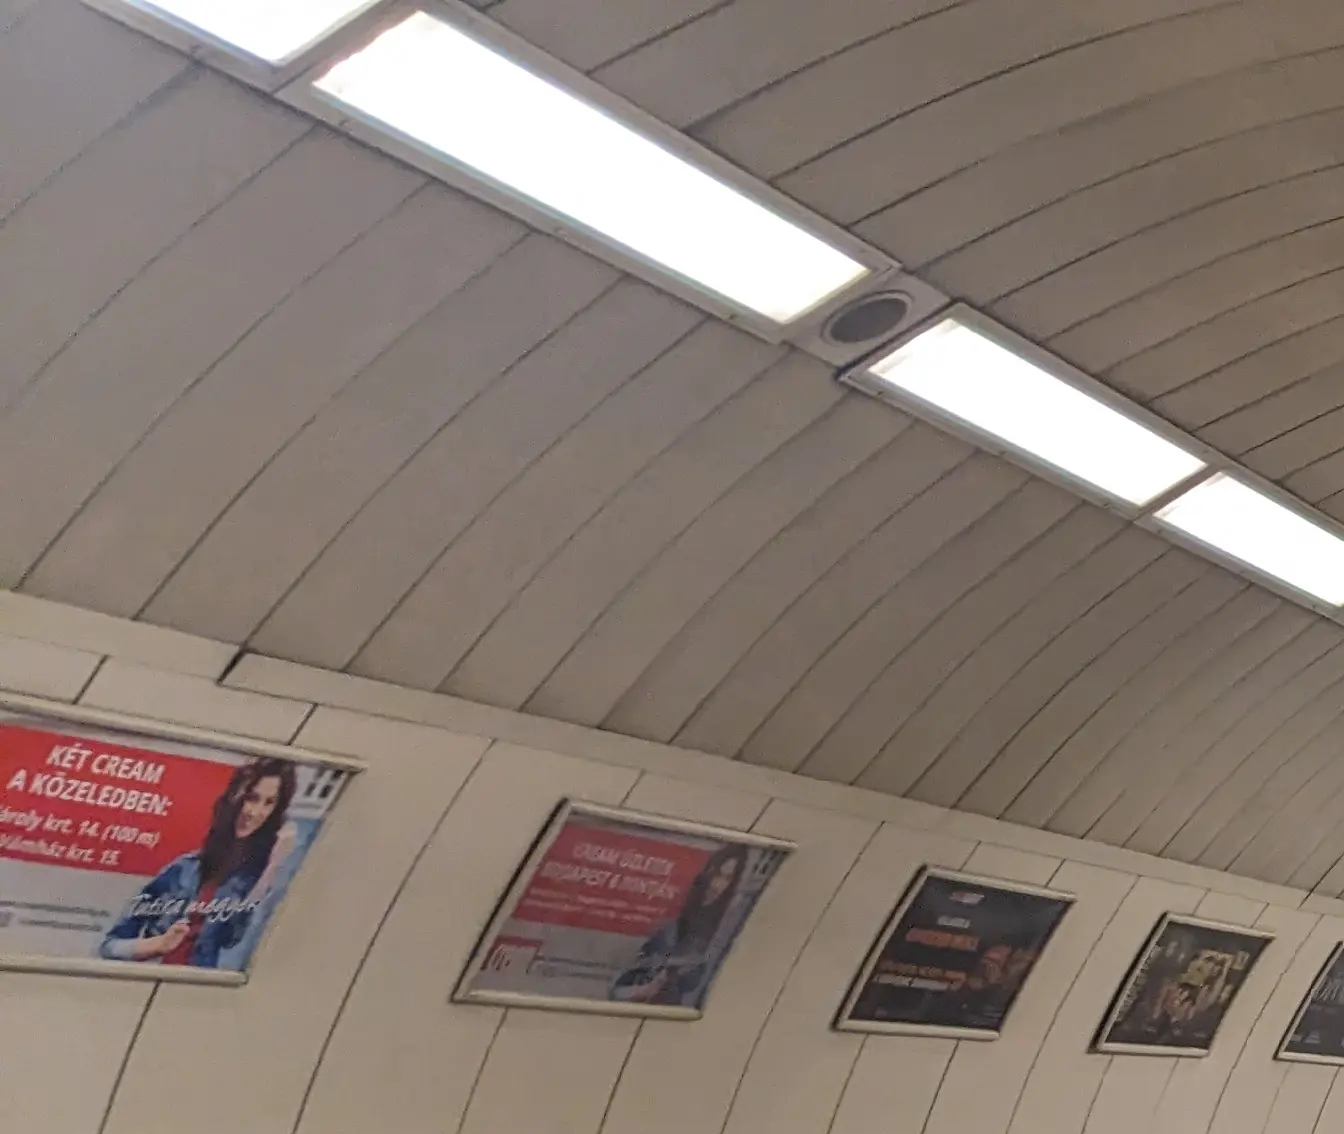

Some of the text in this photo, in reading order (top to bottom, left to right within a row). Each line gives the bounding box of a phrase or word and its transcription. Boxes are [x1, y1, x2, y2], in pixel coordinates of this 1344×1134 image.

[47, 743, 165, 783] KÉT CREAM
[9, 770, 26, 791] A
